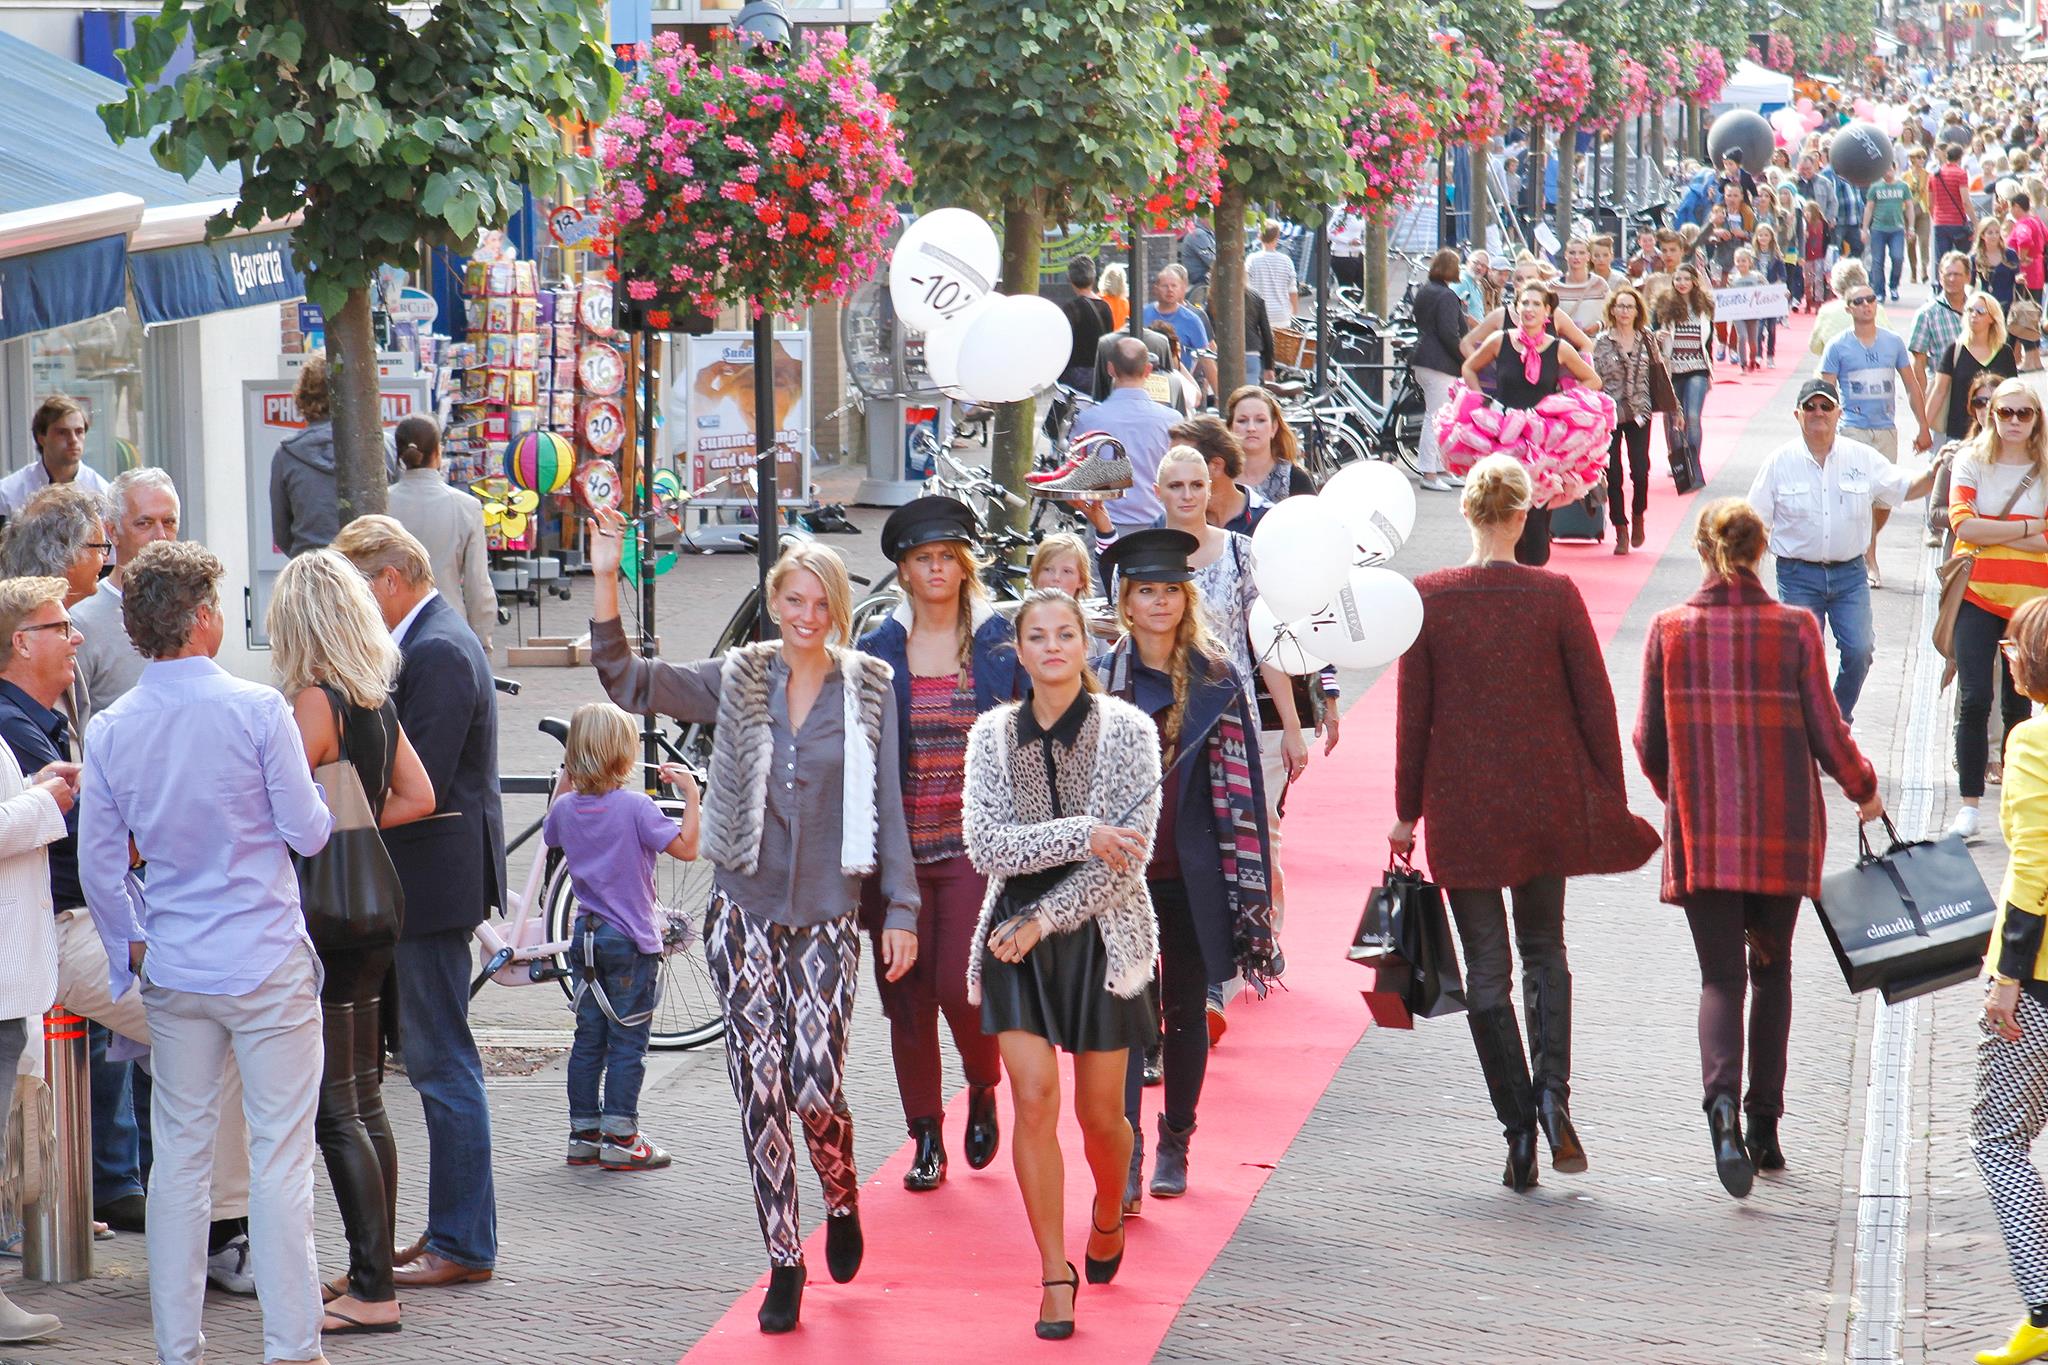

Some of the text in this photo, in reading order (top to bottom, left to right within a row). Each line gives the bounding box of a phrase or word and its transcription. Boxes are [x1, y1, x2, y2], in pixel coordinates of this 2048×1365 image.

[230, 241, 285, 296] Bavaria
[910, 275, 976, 320] -10%
[588, 298, 611, 320] 16
[724, 347, 753, 358] Sund
[591, 416, 612, 438] 30
[711, 453, 737, 469] and
[589, 475, 611, 498] 40
[1866, 916, 1915, 940] claudi
